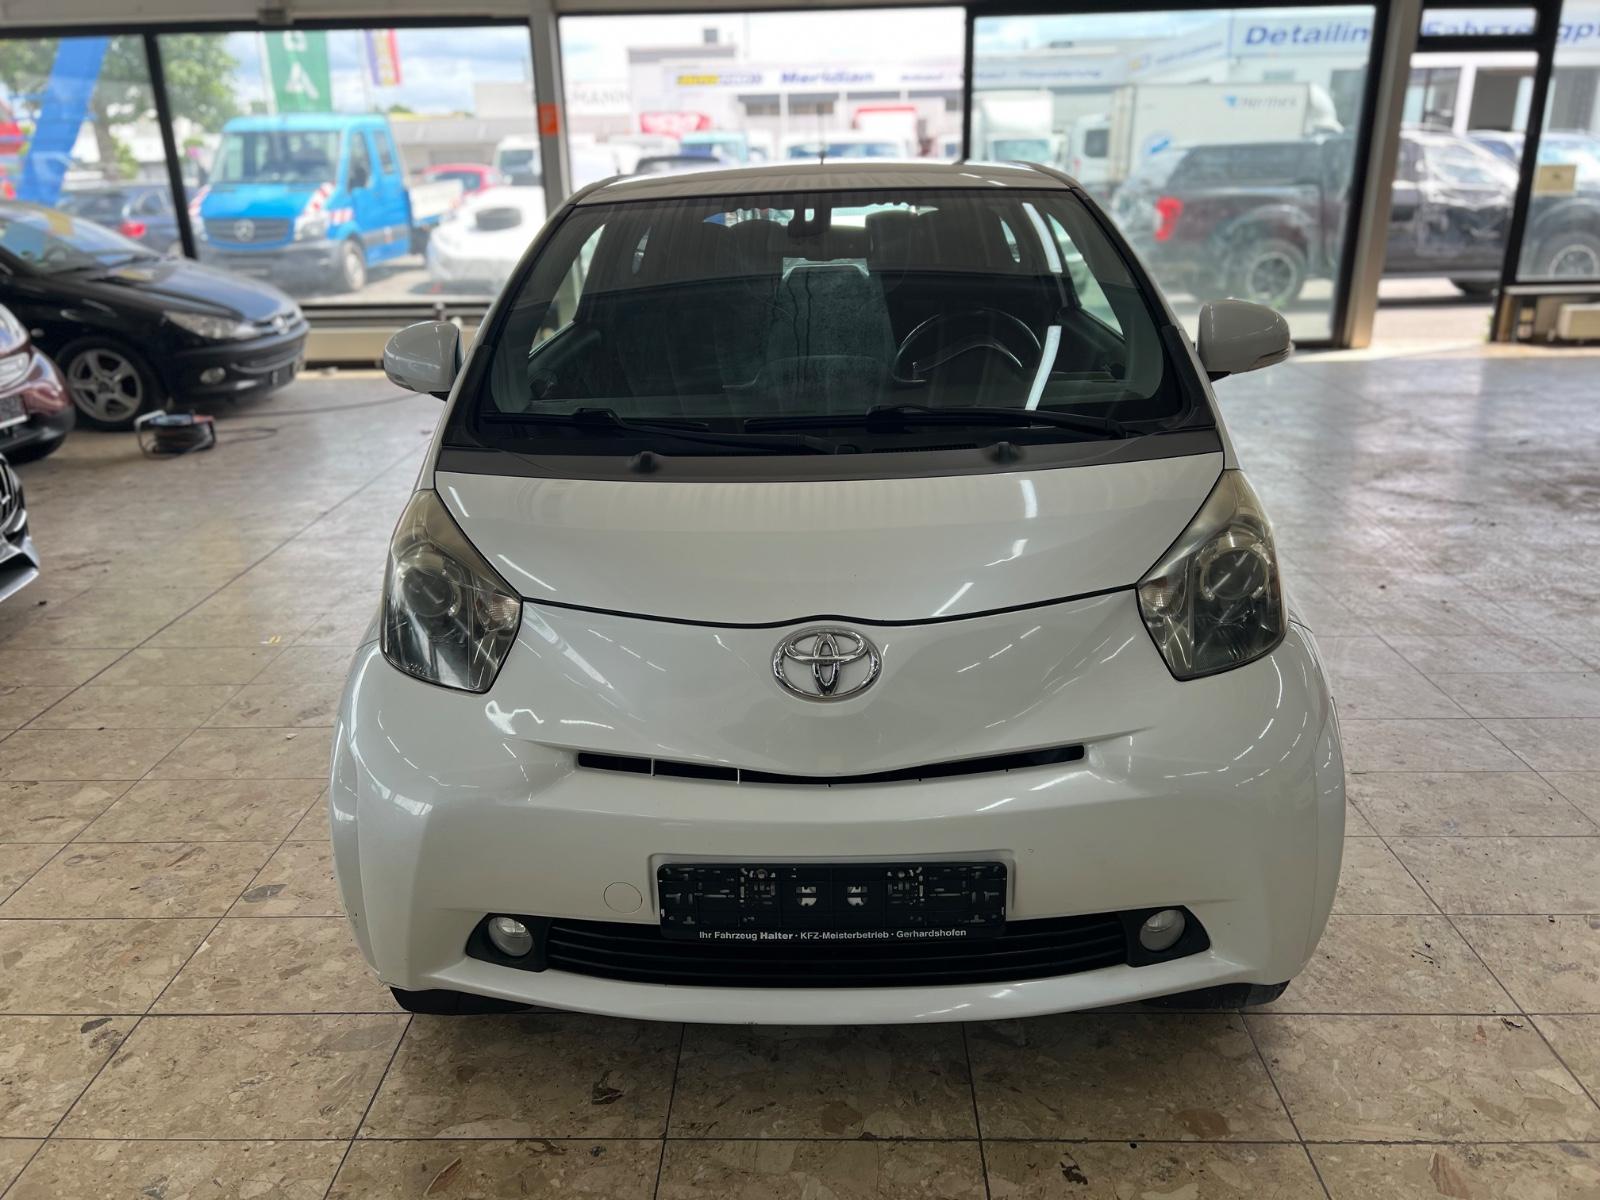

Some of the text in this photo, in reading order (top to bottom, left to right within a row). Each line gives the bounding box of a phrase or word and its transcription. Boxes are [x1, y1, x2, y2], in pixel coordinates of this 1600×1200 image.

[1244, 23, 1370, 45] Detailin
[699, 929, 967, 942] Ihr Fahrzeug Halter KFZ-Meisterbetrieb Gerhardshofen
